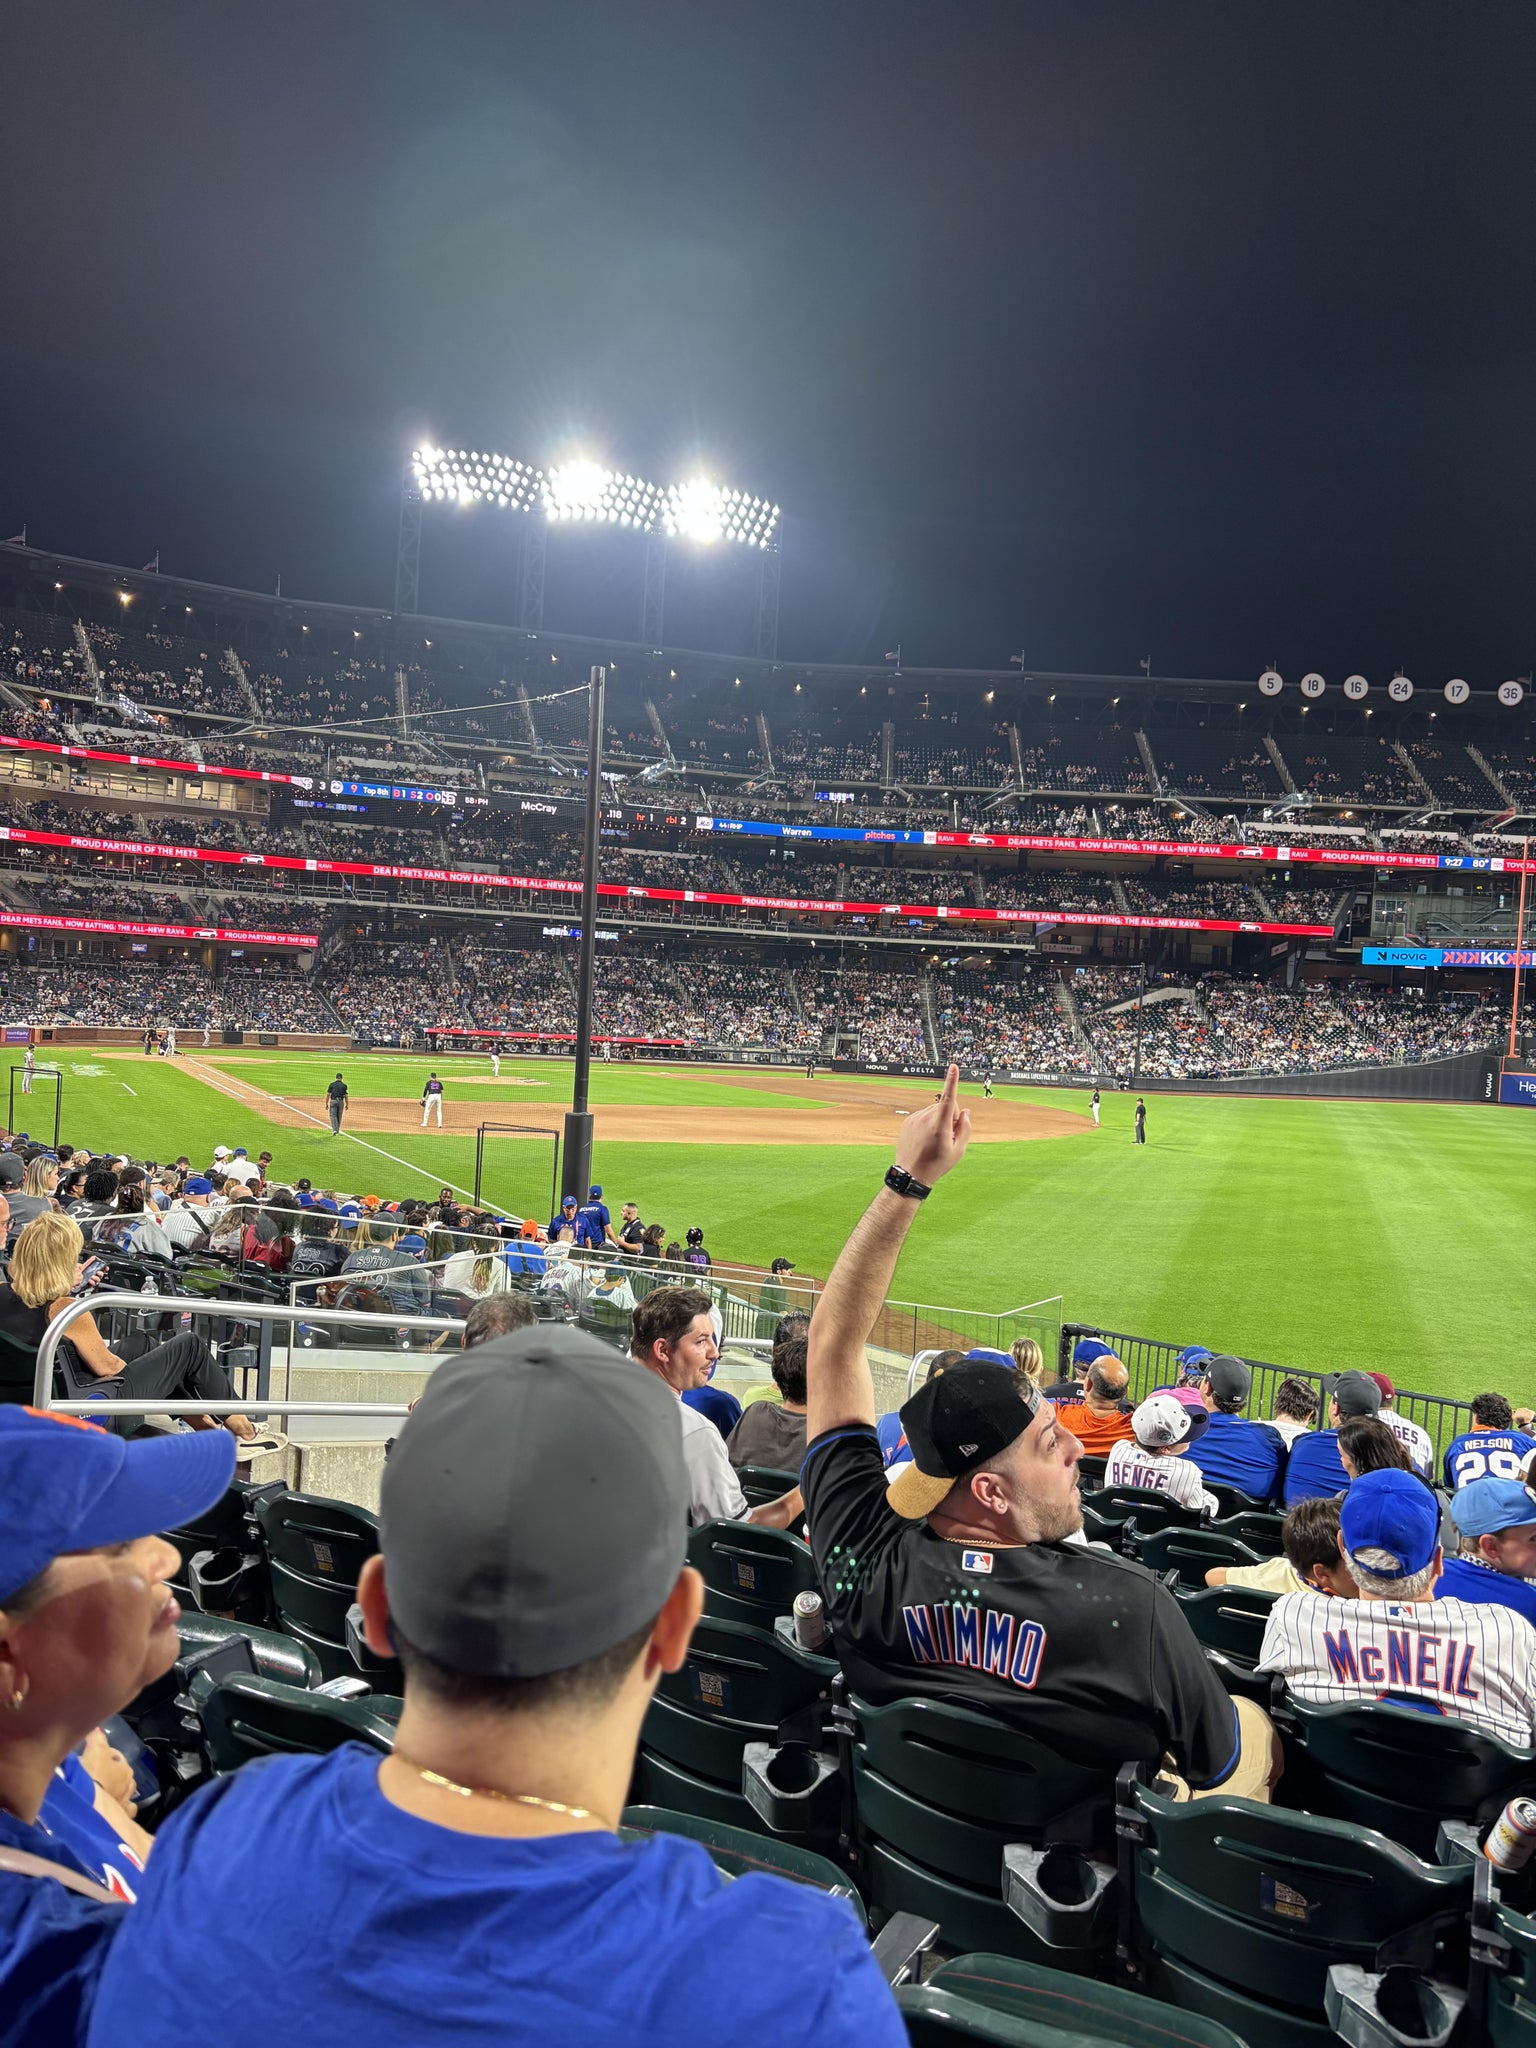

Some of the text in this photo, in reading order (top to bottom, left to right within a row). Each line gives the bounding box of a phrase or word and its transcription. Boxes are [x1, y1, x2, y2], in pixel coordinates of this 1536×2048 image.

[1266, 678, 1274, 689] 5
[1308, 680, 1319, 691] 18
[1351, 682, 1362, 693] 16
[1393, 683, 1408, 695] 24
[1451, 685, 1463, 697] 17
[1503, 688, 1518, 699] 36
[319, 781, 326, 790] 3
[350, 784, 358, 793] 9
[363, 787, 376, 796] Top
[377, 788, 389, 796] 8th
[521, 802, 557, 815] McCray
[606, 810, 622, 819] .118
[636, 813, 645, 821] hr
[666, 816, 677, 824] rbi
[680, 817, 687, 825] 2
[782, 827, 812, 836] Warren
[865, 831, 896, 841] pitches
[904, 832, 910, 840] 9
[71, 838, 198, 858] PROUD PARTNER OF THE METS
[1008, 838, 1222, 854] DEAR METS FANS, NOW BATTING: THE ALL-NEW RAV4.
[1321, 852, 1348, 860] PROUD
[1350, 854, 1385, 862] PARTNER
[1399, 856, 1414, 864] THE
[1415, 857, 1436, 865] METS
[1444, 858, 1489, 868] 9:27 80°
[373, 866, 583, 891] DEAR METS FANS, NOW BATTING: THE ALL-NEW RAV
[742, 898, 766, 906] PROUD
[767, 899, 798, 908] PARTNER
[824, 903, 844, 911] METS
[1, 915, 21, 923] DEAR
[23, 917, 42, 925] METS
[43, 918, 64, 928] FANS,
[65, 920, 84, 928] NOW
[118, 924, 130, 932] THE
[132, 925, 165, 935] ALL-NEW
[997, 911, 1202, 928] DEAR METS FANS, NOW BATTING: THE ALL-NEW RAV4.
[224, 931, 317, 945] PROUD PARTNER OF THE METS
[1391, 953, 1427, 961] NOVIG
[1011, 1072, 1030, 1080] BASEBALL
[1485, 1073, 1493, 1098] 335
[356, 1255, 390, 1269] SOTO
[1464, 1438, 1513, 1451] NELSON
[1112, 1462, 1169, 1490] BENGE
[902, 1603, 1047, 1690] NIMMO
[1323, 1629, 1479, 1700] McNEIL
